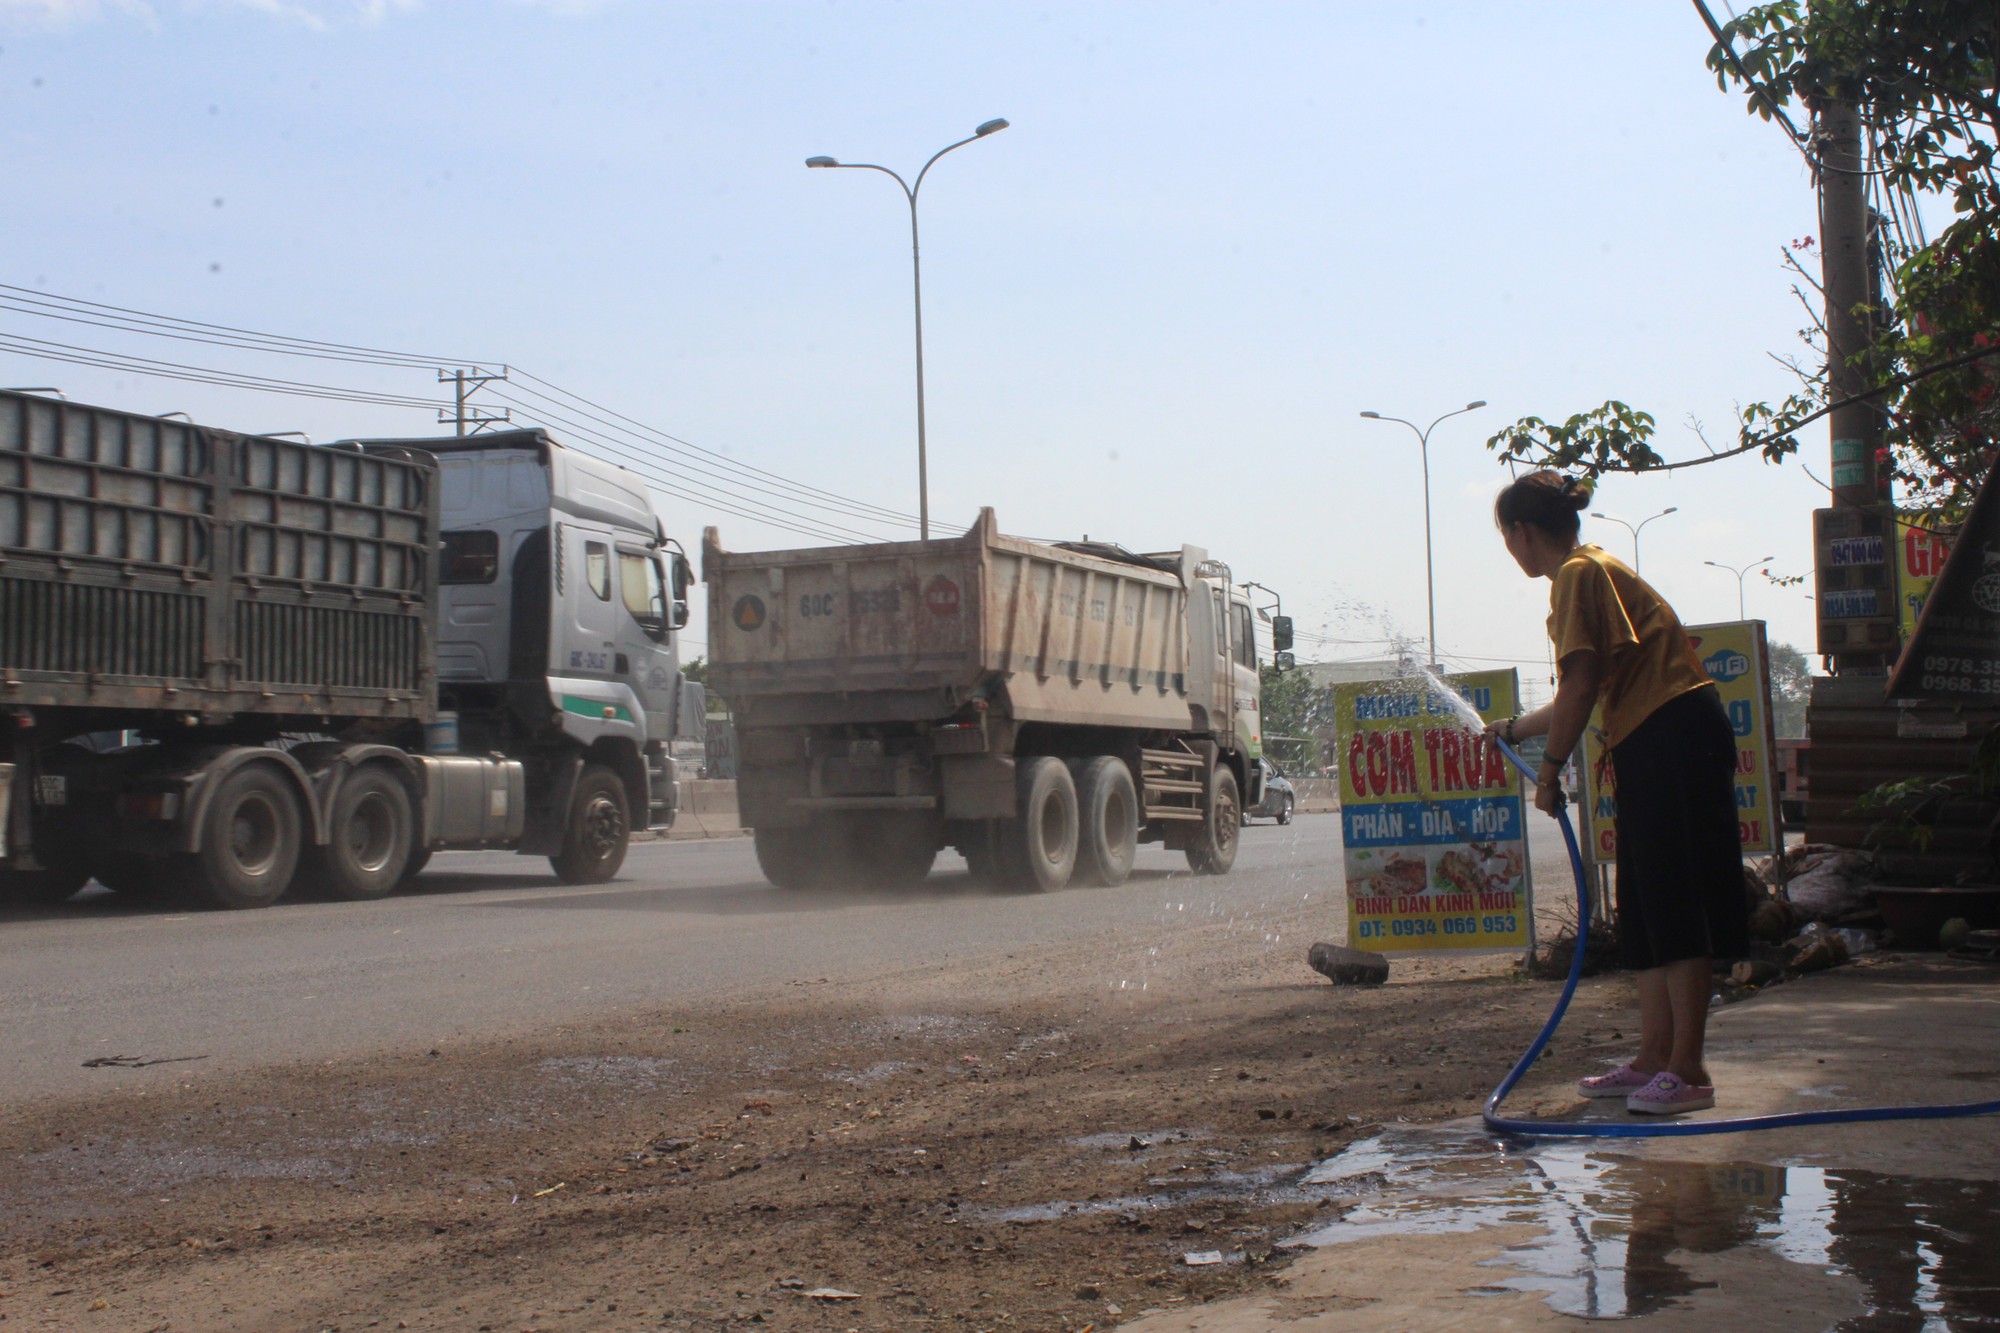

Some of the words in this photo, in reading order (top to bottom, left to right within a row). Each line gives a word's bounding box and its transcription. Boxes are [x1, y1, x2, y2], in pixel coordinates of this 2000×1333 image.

[1355, 694, 1420, 721] MINH
[1472, 802, 1511, 839] HỘP
[1392, 918, 1438, 936] 0934
[1443, 916, 1477, 934] 066
[1482, 915, 1517, 933] 953
